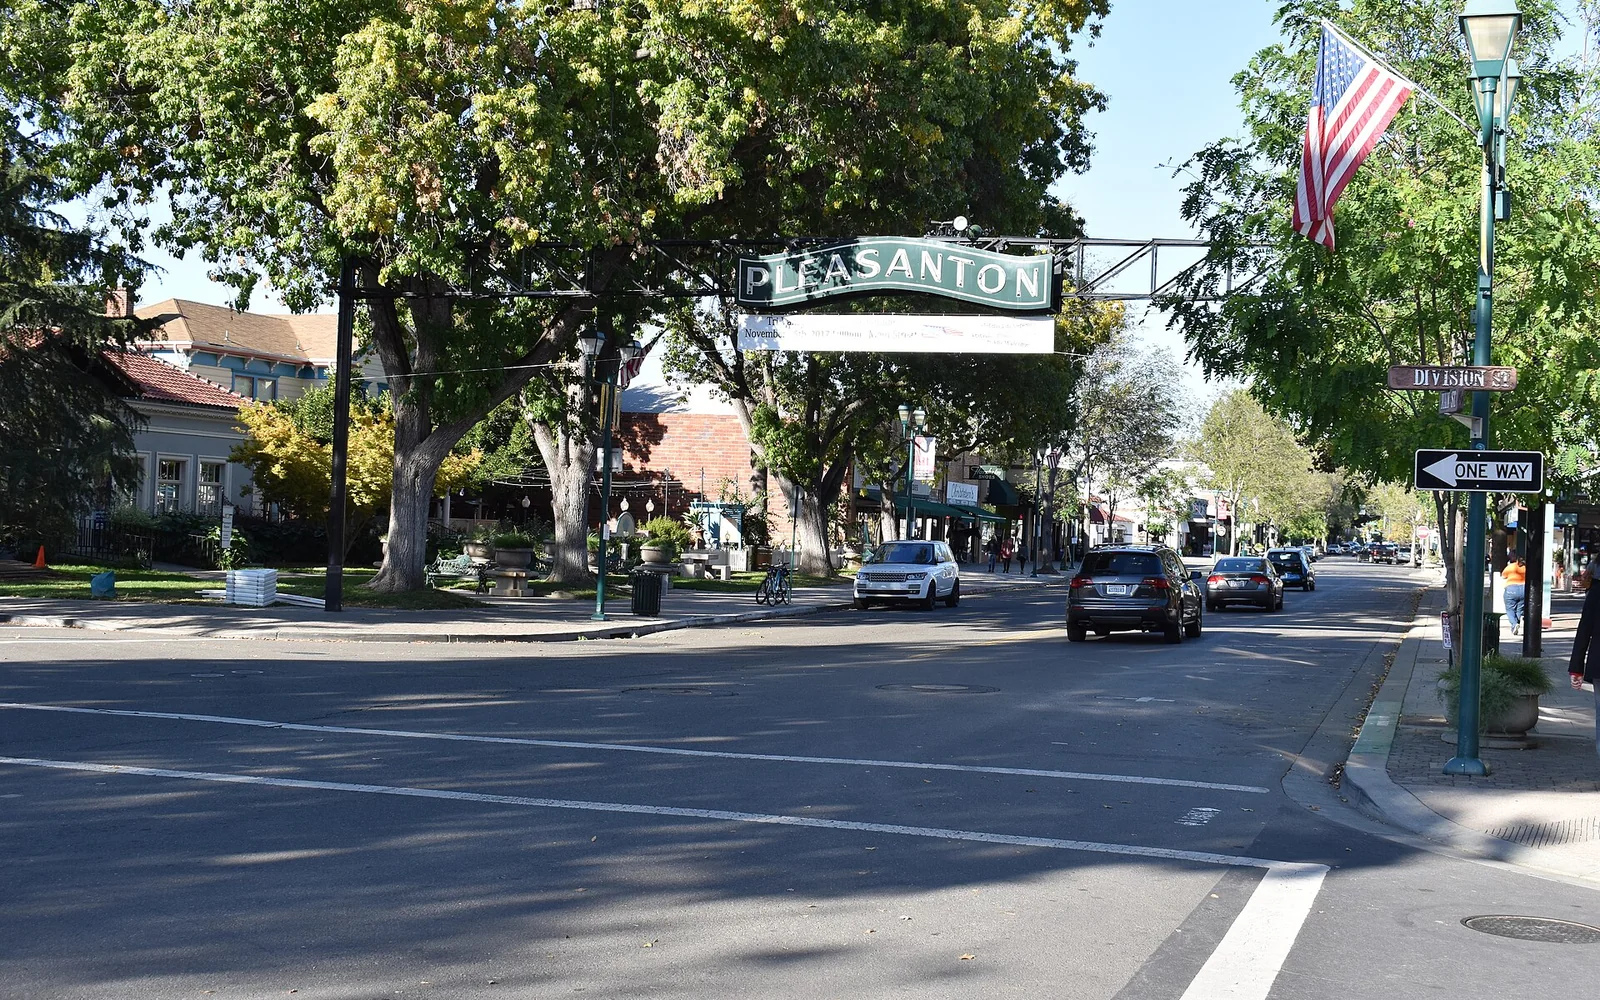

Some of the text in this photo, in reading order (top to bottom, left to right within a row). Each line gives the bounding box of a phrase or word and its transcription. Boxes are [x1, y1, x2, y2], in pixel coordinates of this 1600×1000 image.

[746, 248, 1039, 298] PLEASANTON
[745, 329, 785, 340] Novembe
[1413, 368, 1485, 387] DIVISION
[1455, 463, 1530, 479] ONE WAY
